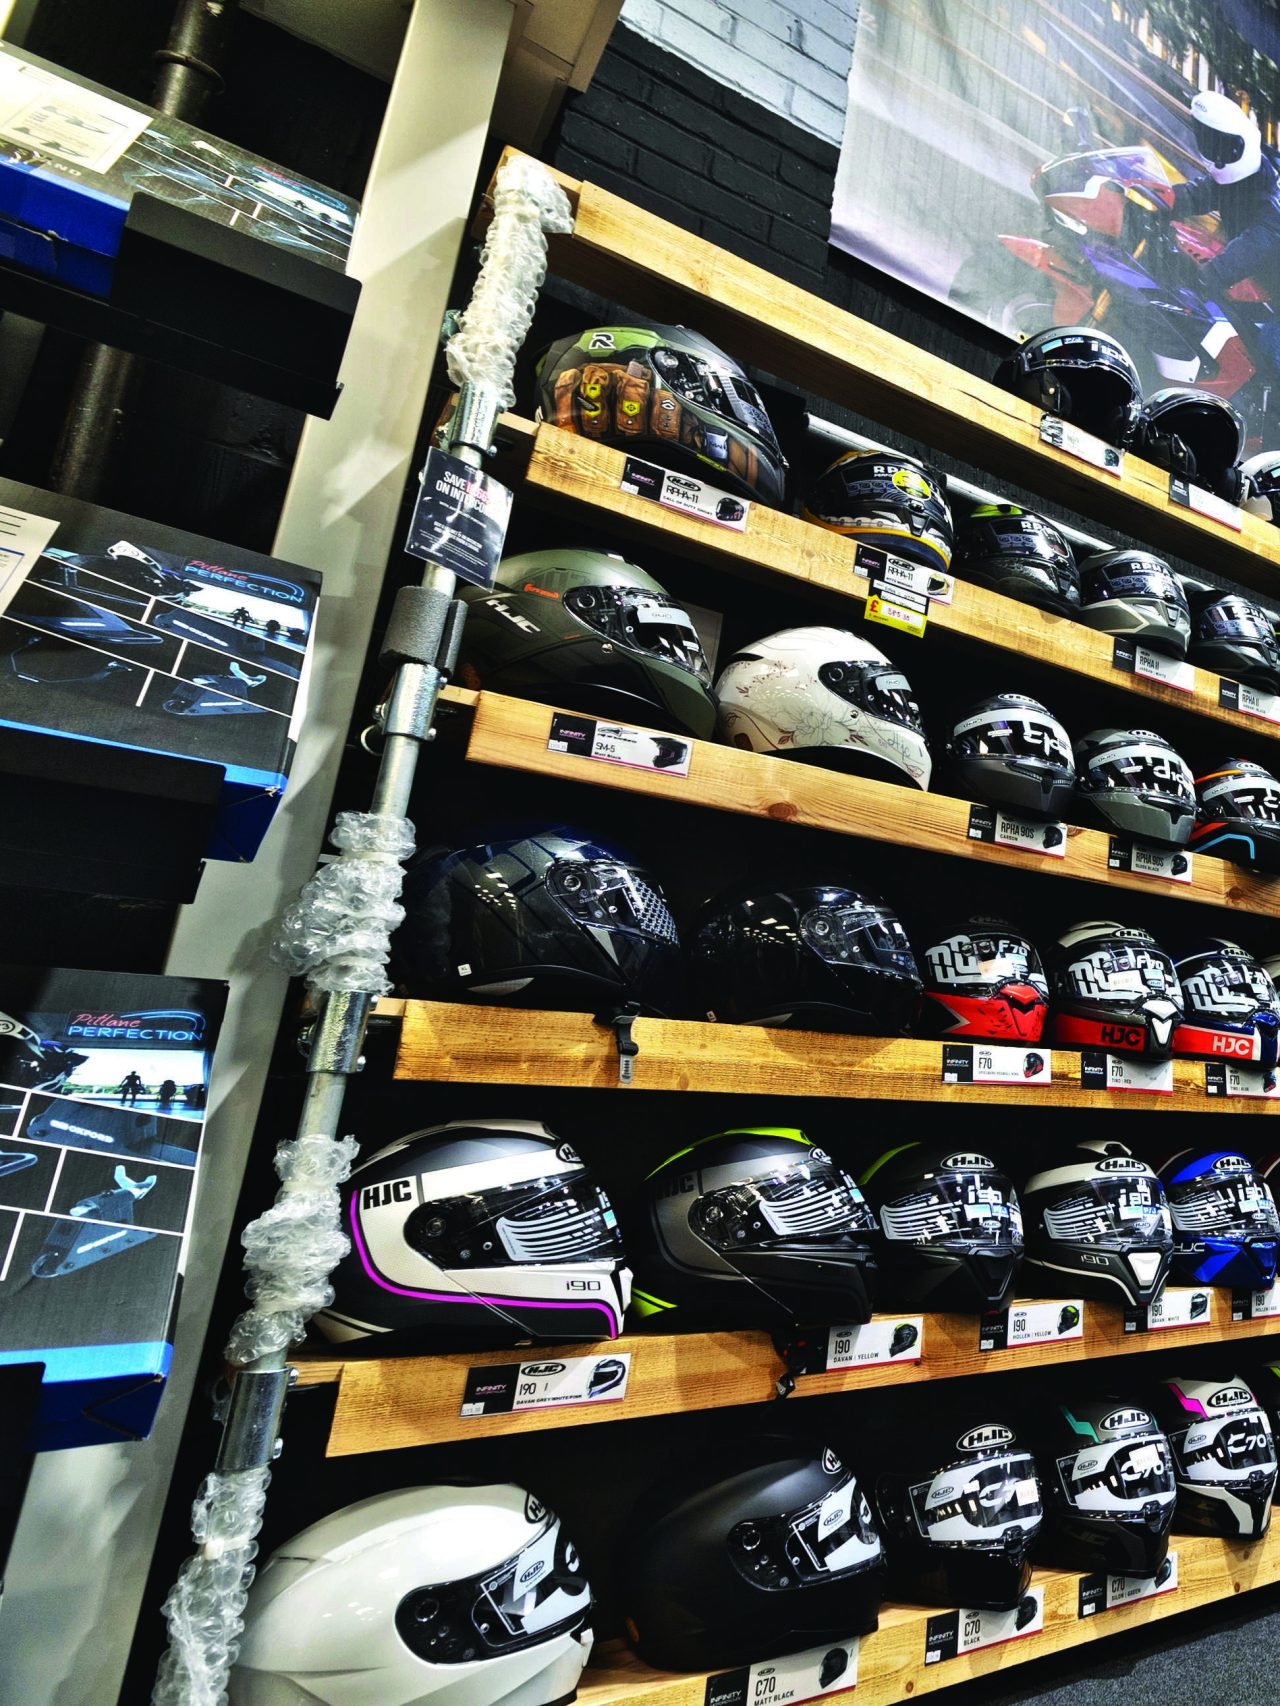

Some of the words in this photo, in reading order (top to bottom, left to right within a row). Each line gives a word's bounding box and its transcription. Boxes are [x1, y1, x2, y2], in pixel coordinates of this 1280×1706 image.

[435, 479, 449, 495] ON
[443, 471, 467, 491] SAVE
[666, 484, 699, 504] RPHA-11
[187, 559, 249, 581] Pitlane
[887, 565, 914, 582] RPHA-11
[184, 565, 304, 603] PERFECTION
[485, 598, 541, 635] HJC
[1000, 821, 1020, 837] RPHA
[1135, 851, 1151, 865] RPHA
[999, 940, 1028, 955] F70
[72, 1012, 142, 1029] Pitlane
[67, 1025, 203, 1041] PERFECTION
[1101, 1023, 1142, 1047] HJC
[1211, 1035, 1251, 1056] HJC
[978, 1057, 993, 1070] F70
[1111, 1066, 1123, 1077] F70
[1230, 1074, 1241, 1086] F70
[951, 1155, 992, 1169] HJC
[1104, 1160, 1143, 1171] HJC
[1219, 1158, 1251, 1169] HJC
[362, 1178, 412, 1211] HJC
[1173, 1242, 1206, 1253] HJC
[1081, 1255, 1109, 1266] i90
[566, 1280, 601, 1292] i90
[857, 1352, 879, 1361] YELLOW
[1214, 1390, 1250, 1406] HJC
[1108, 1412, 1149, 1428] HJC
[967, 1427, 1013, 1447] HJC
[1227, 1431, 1266, 1454] C70
[523, 1561, 544, 1583] HJC
[1111, 1576, 1126, 1592] C70
[964, 1619, 981, 1637] C70
[928, 1631, 955, 1642] INFINITY
[963, 1637, 980, 1646] BLACK
[755, 1676, 776, 1697] C70
[711, 1689, 742, 1704] INFINITY
[774, 1689, 795, 1701] BLACK
